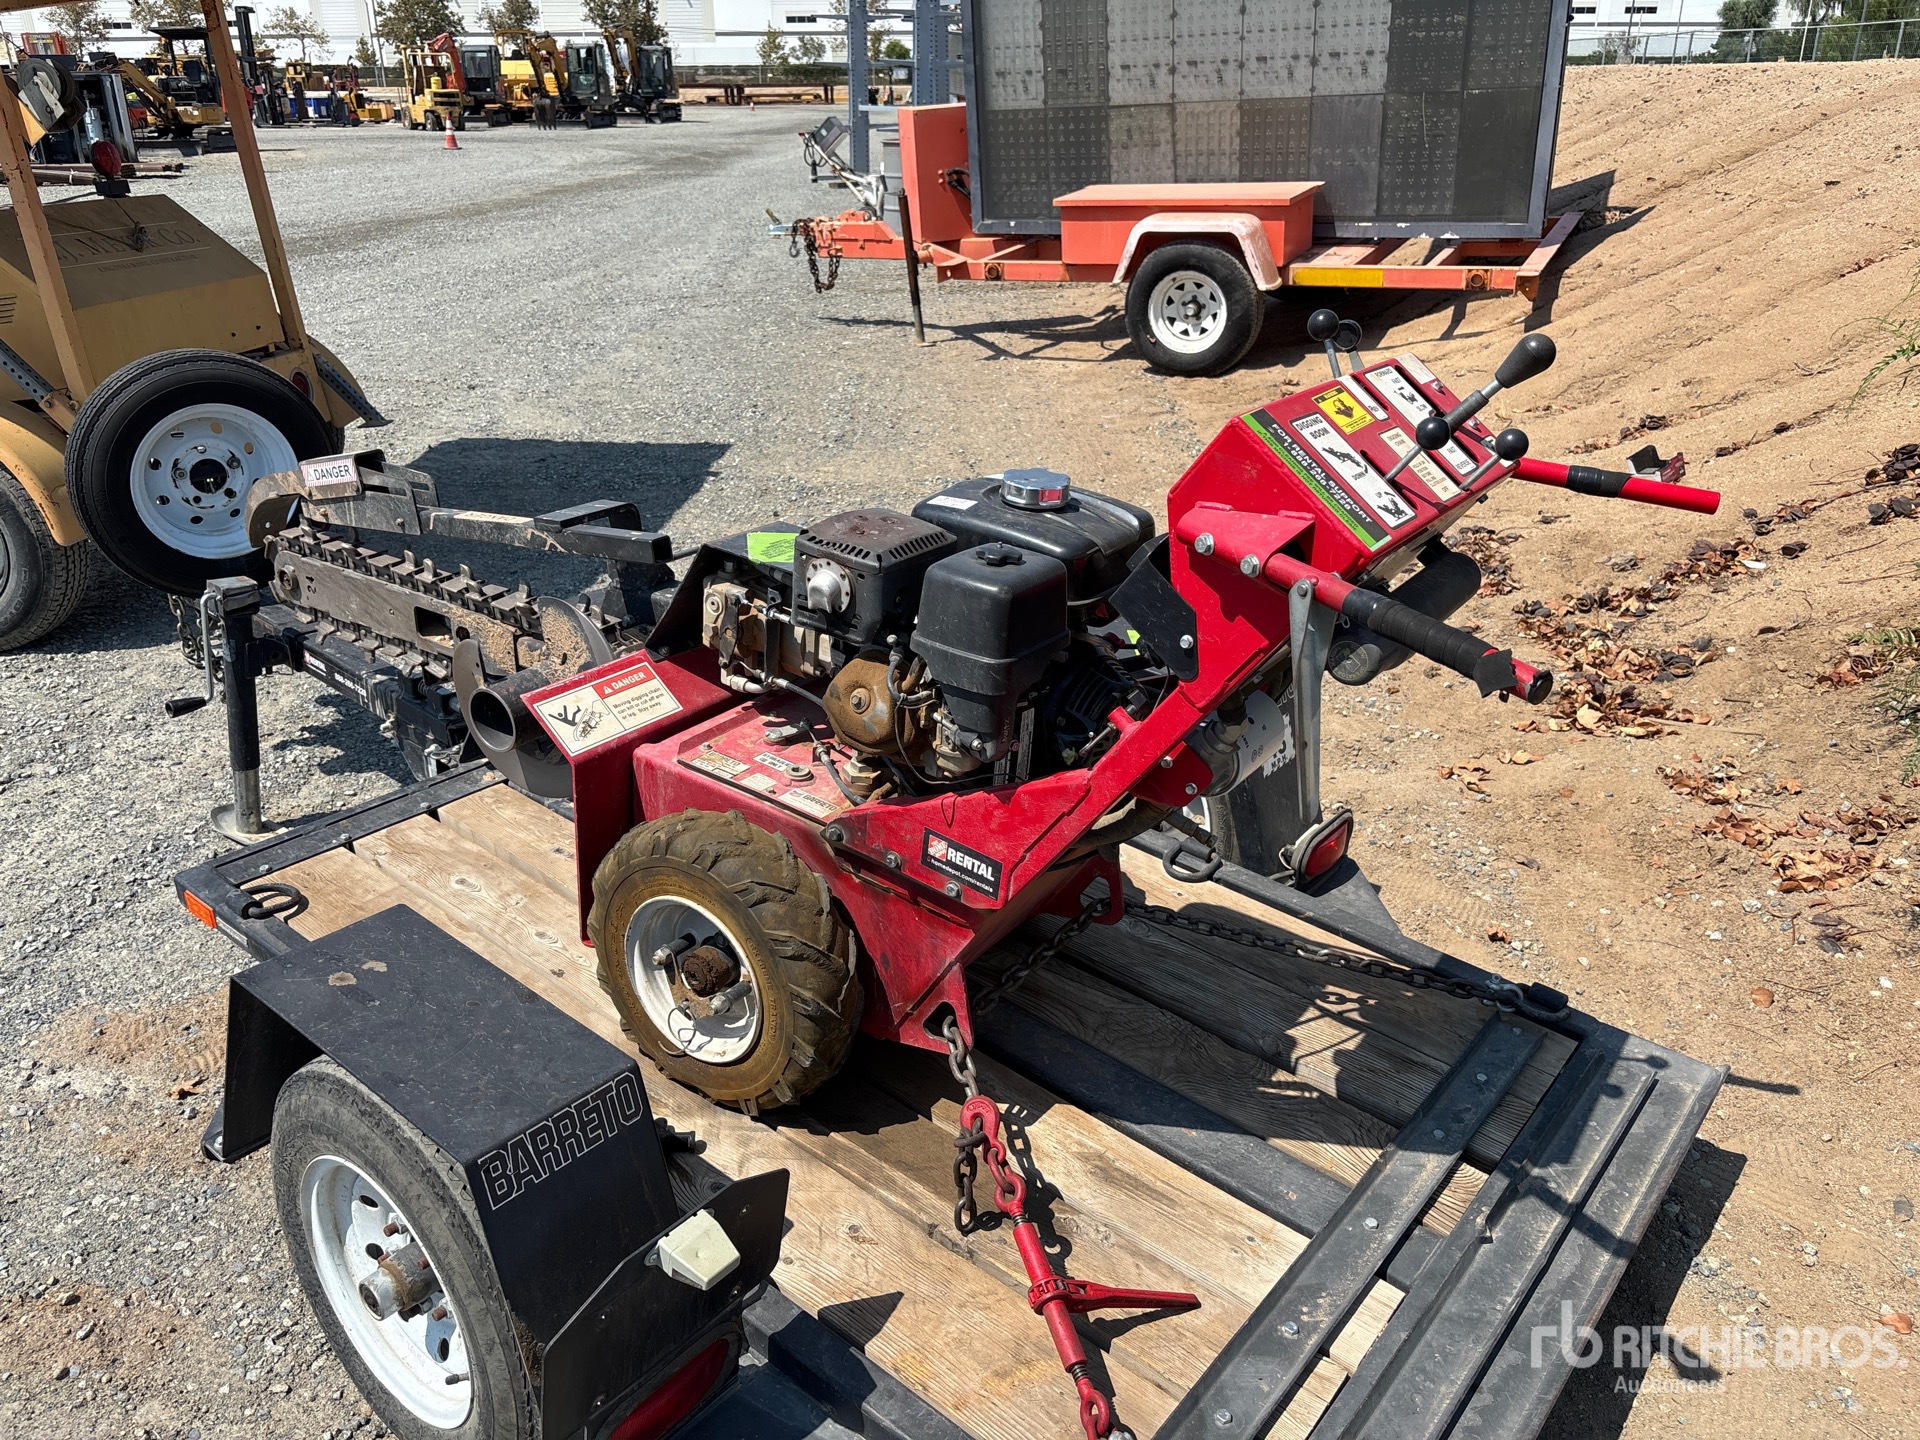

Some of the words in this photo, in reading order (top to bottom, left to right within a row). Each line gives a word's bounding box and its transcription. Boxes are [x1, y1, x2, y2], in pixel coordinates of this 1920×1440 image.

[1295, 416, 1323, 431] DIGGING
[1309, 427, 1330, 440] BOOM
[313, 464, 351, 481] DANGER
[1271, 424, 1292, 443] FOR
[1292, 444, 1327, 479] RENTAL
[1328, 480, 1373, 523] SUPPORT
[611, 671, 646, 690] DANGER
[613, 699, 631, 709] Moving
[631, 692, 649, 702] digging
[648, 687, 661, 695] chain
[803, 794, 838, 812] BARRETO
[947, 847, 995, 881] RENTAL
[931, 858, 993, 892] homedepot.com/rentals
[477, 1071, 643, 1211] BARRETO
